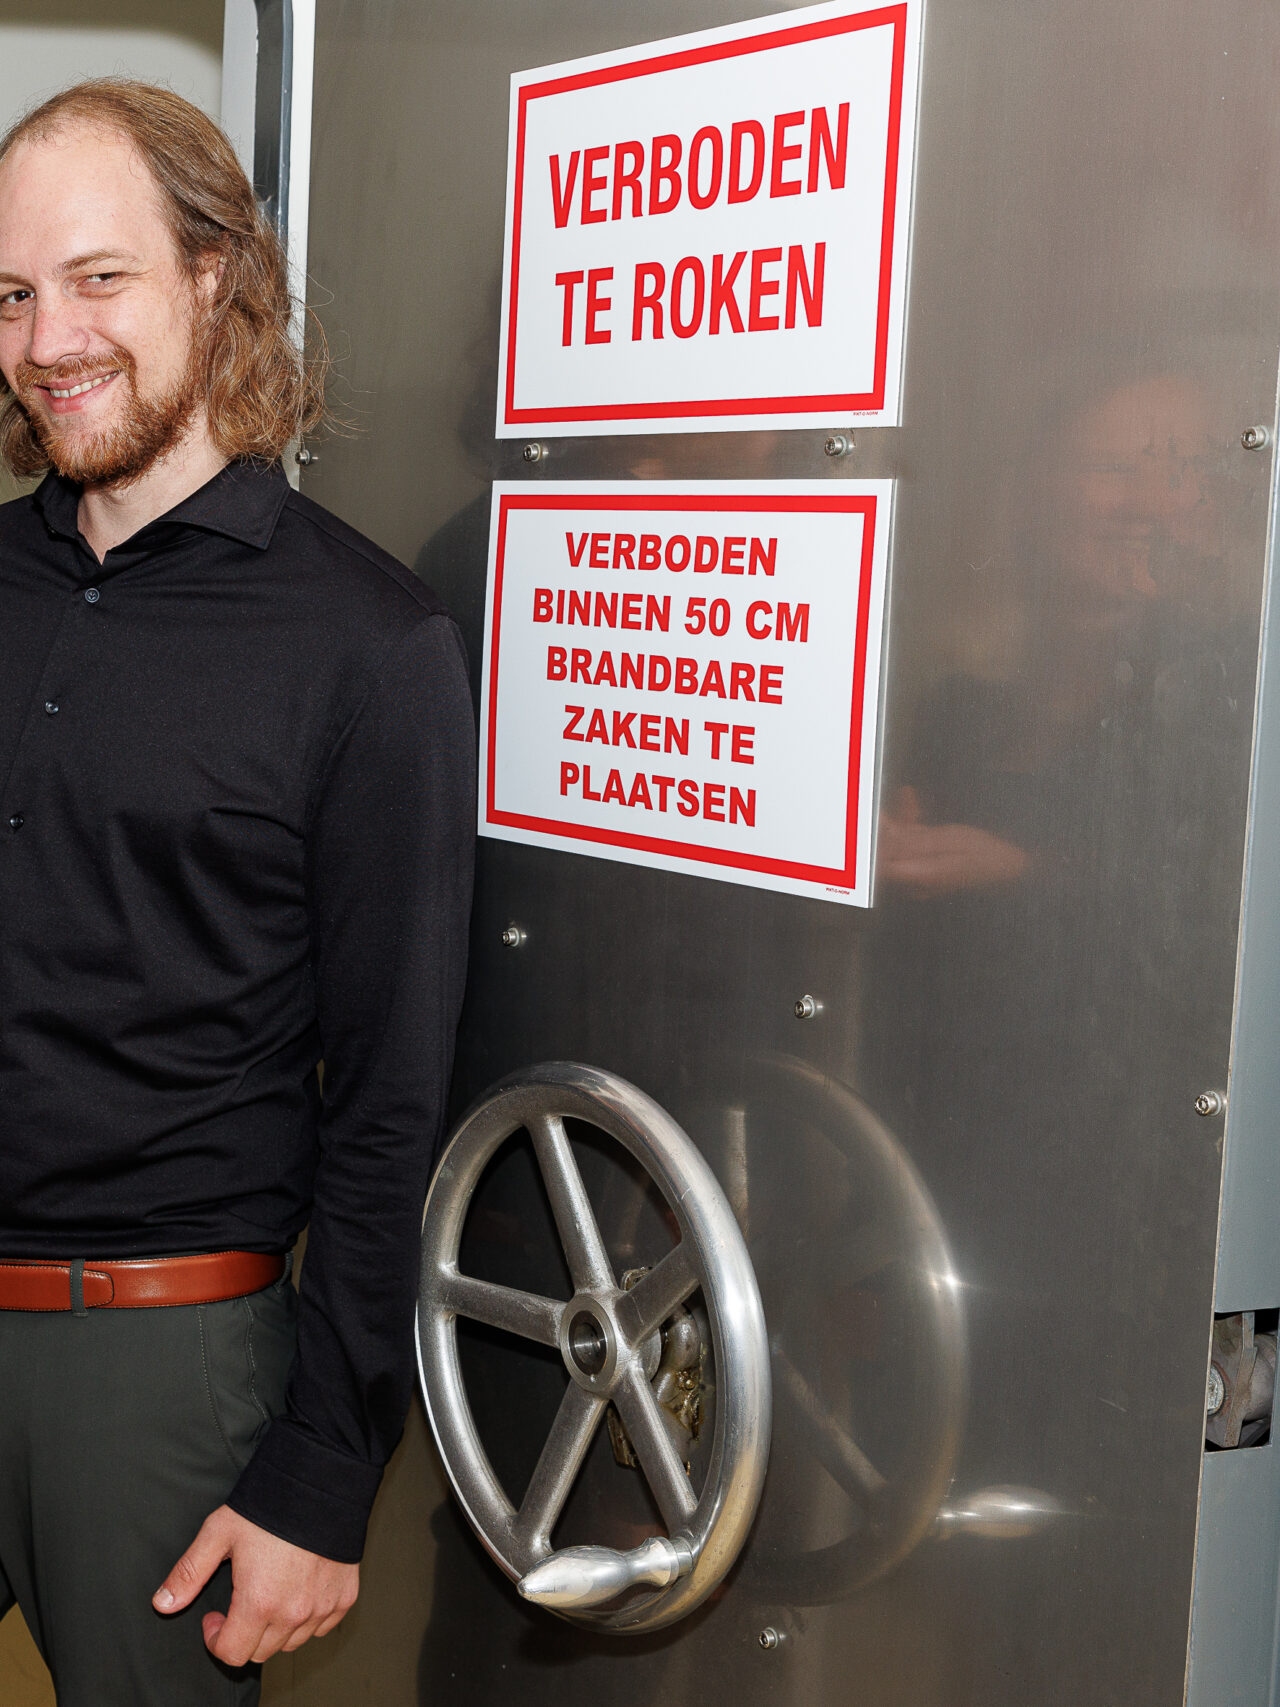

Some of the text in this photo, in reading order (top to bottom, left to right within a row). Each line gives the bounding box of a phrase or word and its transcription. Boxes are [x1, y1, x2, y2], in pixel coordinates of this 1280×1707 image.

[549, 102, 850, 229] VERBODEN
[555, 242, 826, 347] TE ROKEN
[566, 532, 777, 577] VERBODEN
[533, 588, 810, 643] BINNEN 50 CM
[547, 646, 784, 705] BRANDBARE
[563, 705, 755, 764] ZAKEN TE
[560, 762, 757, 828] PLAATSEN
